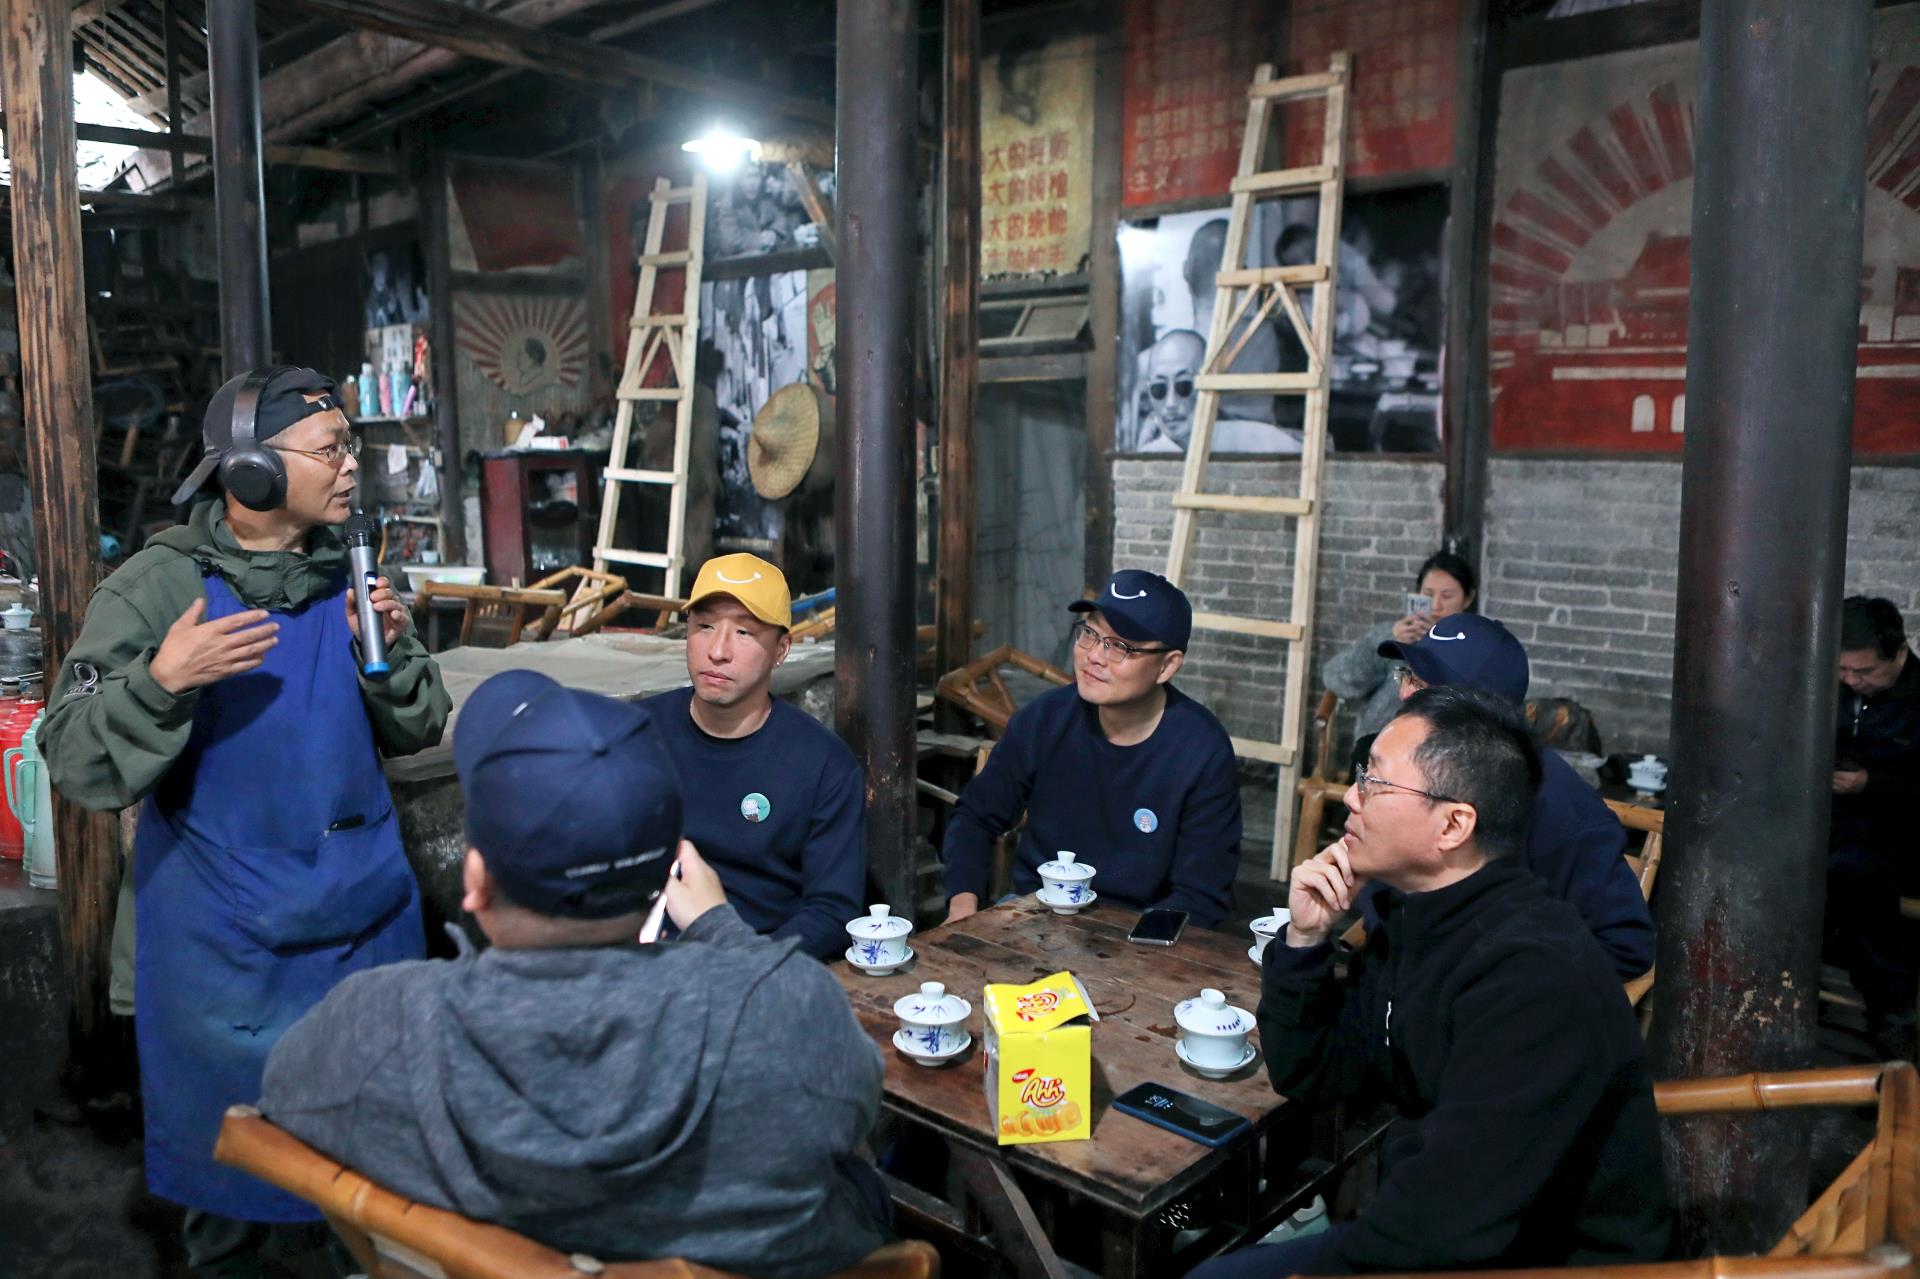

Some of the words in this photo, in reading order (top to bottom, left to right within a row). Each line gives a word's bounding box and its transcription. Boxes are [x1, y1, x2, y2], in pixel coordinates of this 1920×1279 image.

[979, 131, 1070, 174] 大的导师
[979, 168, 1069, 206] 大的领袖
[979, 206, 1068, 241] 大的统帅
